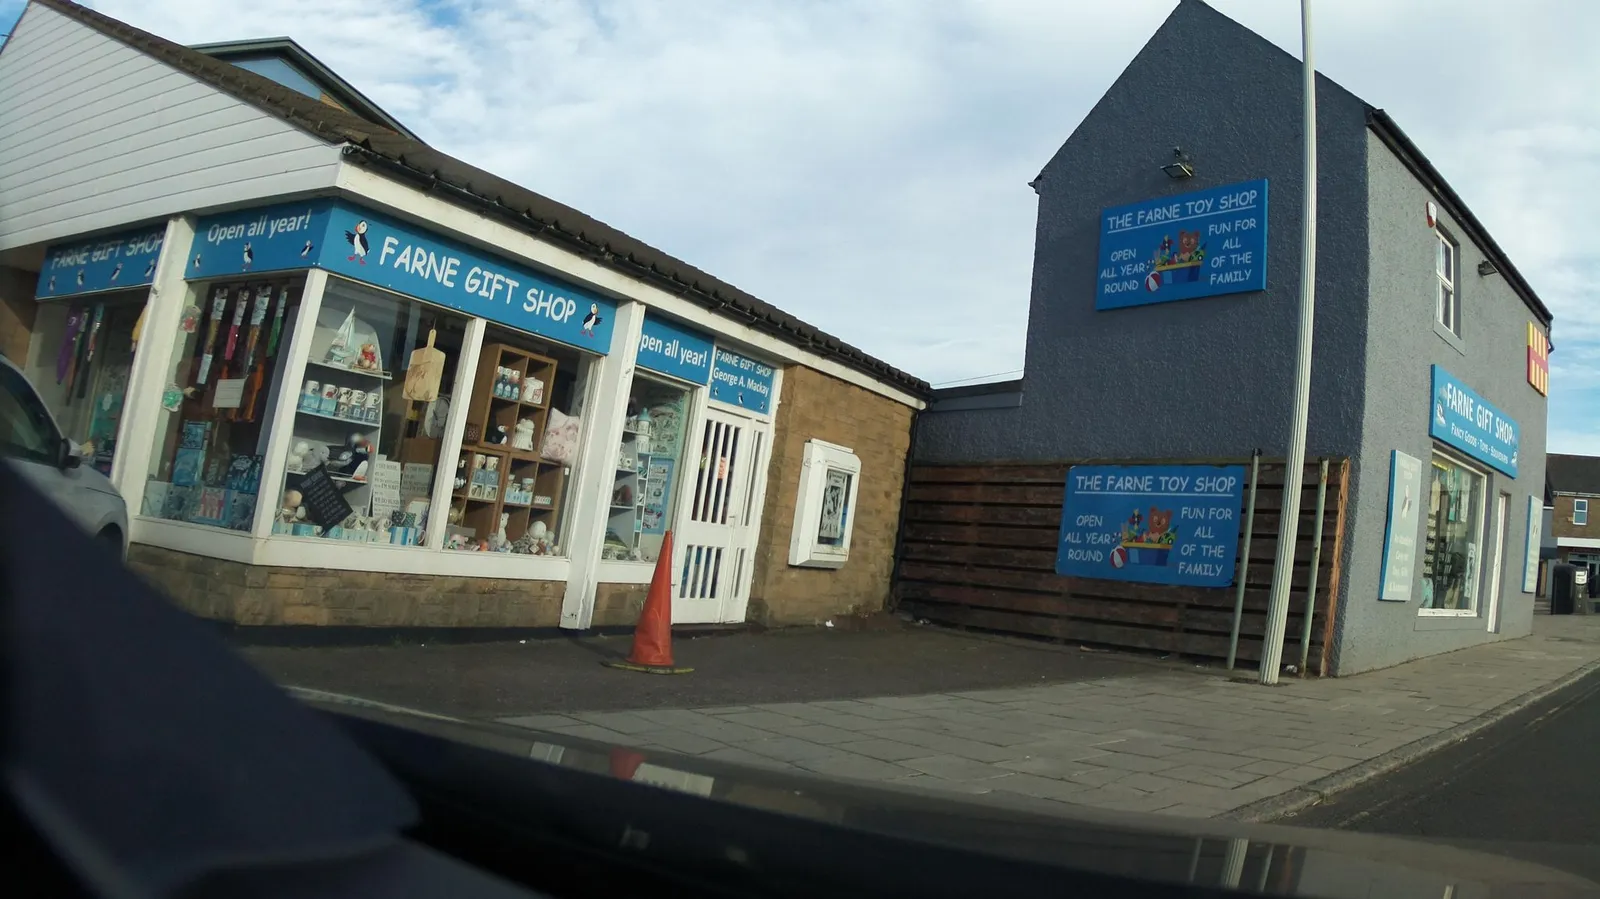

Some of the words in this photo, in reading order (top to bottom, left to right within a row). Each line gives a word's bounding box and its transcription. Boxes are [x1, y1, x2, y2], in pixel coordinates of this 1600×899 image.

[1107, 212, 1133, 230] THE
[1137, 204, 1181, 225] FARNE
[1185, 198, 1214, 215] TOY
[1219, 190, 1257, 210] SHOP
[208, 222, 244, 245] Open
[247, 215, 266, 237] all
[268, 208, 312, 239] year!
[1208, 223, 1231, 236] FUN
[1235, 218, 1257, 231] FOR
[51, 244, 91, 270] FARNE
[92, 240, 124, 262] GIFT
[126, 232, 164, 257] SHOP
[1222, 238, 1241, 250] ALL
[1111, 248, 1136, 262] OPEN
[1211, 256, 1226, 268] OF
[1230, 252, 1252, 265] THE
[1100, 268, 1117, 279] ALL
[1120, 262, 1145, 276] YEAR
[1210, 269, 1252, 285] FAMILY
[379, 236, 461, 288] FARNE
[465, 266, 519, 304] GIFT
[522, 288, 577, 323] SHOP
[1104, 279, 1139, 294] ROUND
[640, 334, 662, 353] pen
[664, 339, 679, 358] all
[680, 347, 708, 368] year!
[715, 350, 738, 366] FARNE
[739, 358, 756, 372] GIFT
[756, 364, 772, 377] SHOP
[713, 367, 738, 386] George
[738, 375, 746, 388] A.
[747, 378, 769, 397] Mackay
[1447, 383, 1474, 422] FARNE
[1476, 404, 1493, 434] GIFT
[1495, 417, 1513, 446] SHOP
[1075, 475, 1102, 490] THE
[1106, 475, 1153, 492] FARNE
[1159, 476, 1189, 492] TOY
[1194, 476, 1236, 493] SHOP
[1076, 515, 1103, 527] OPEN
[1181, 507, 1205, 520] FUN
[1208, 508, 1232, 521] FOR
[1064, 532, 1082, 544] ALL
[1085, 532, 1111, 545] YEAR
[1194, 526, 1215, 538] ALL
[1067, 549, 1103, 562] ROUND
[1180, 544, 1197, 557] OF
[1201, 544, 1225, 558] THE
[1178, 562, 1223, 576] FAMILY
